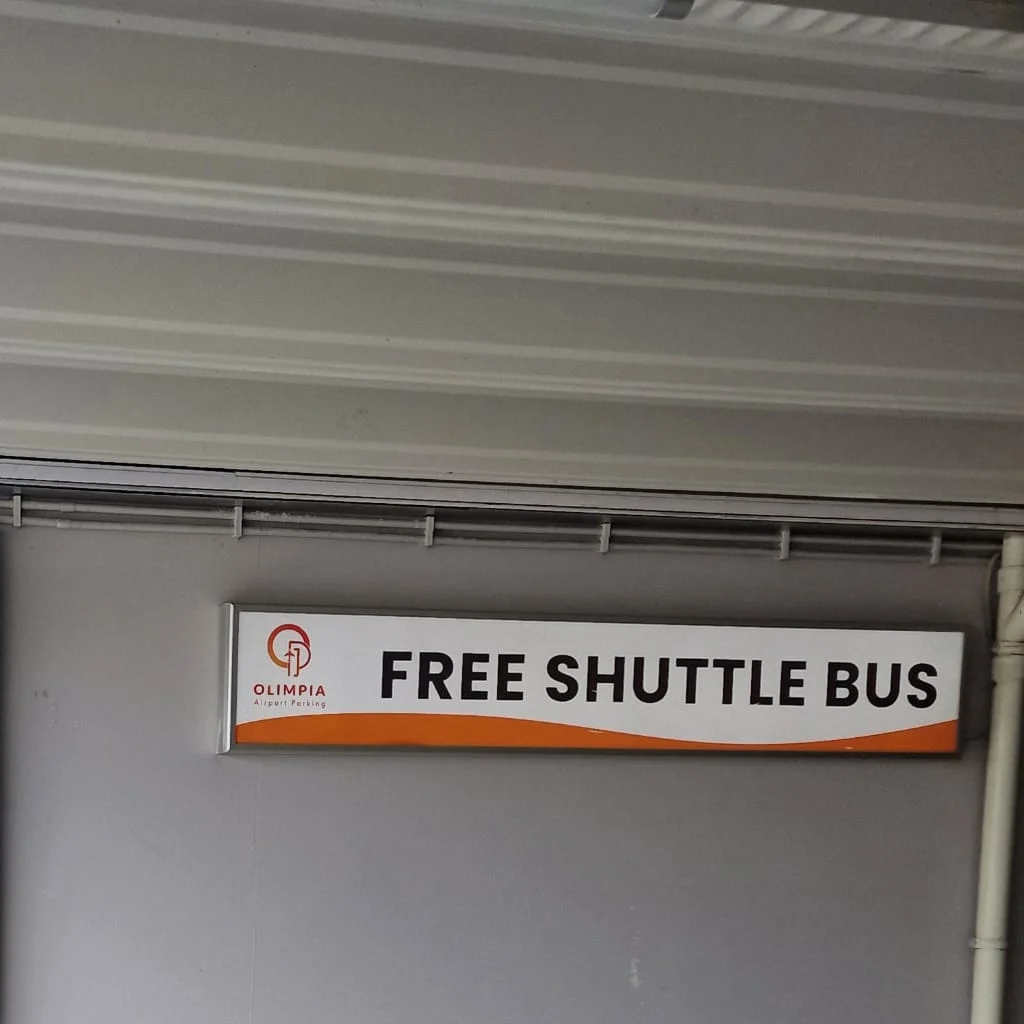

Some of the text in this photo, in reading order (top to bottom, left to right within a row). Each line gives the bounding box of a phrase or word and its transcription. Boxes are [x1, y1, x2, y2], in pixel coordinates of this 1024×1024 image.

[381, 650, 939, 710] FREE SHUTTLE BUS
[253, 684, 326, 697] OLIMPIA
[254, 699, 326, 709] Airport Parking
